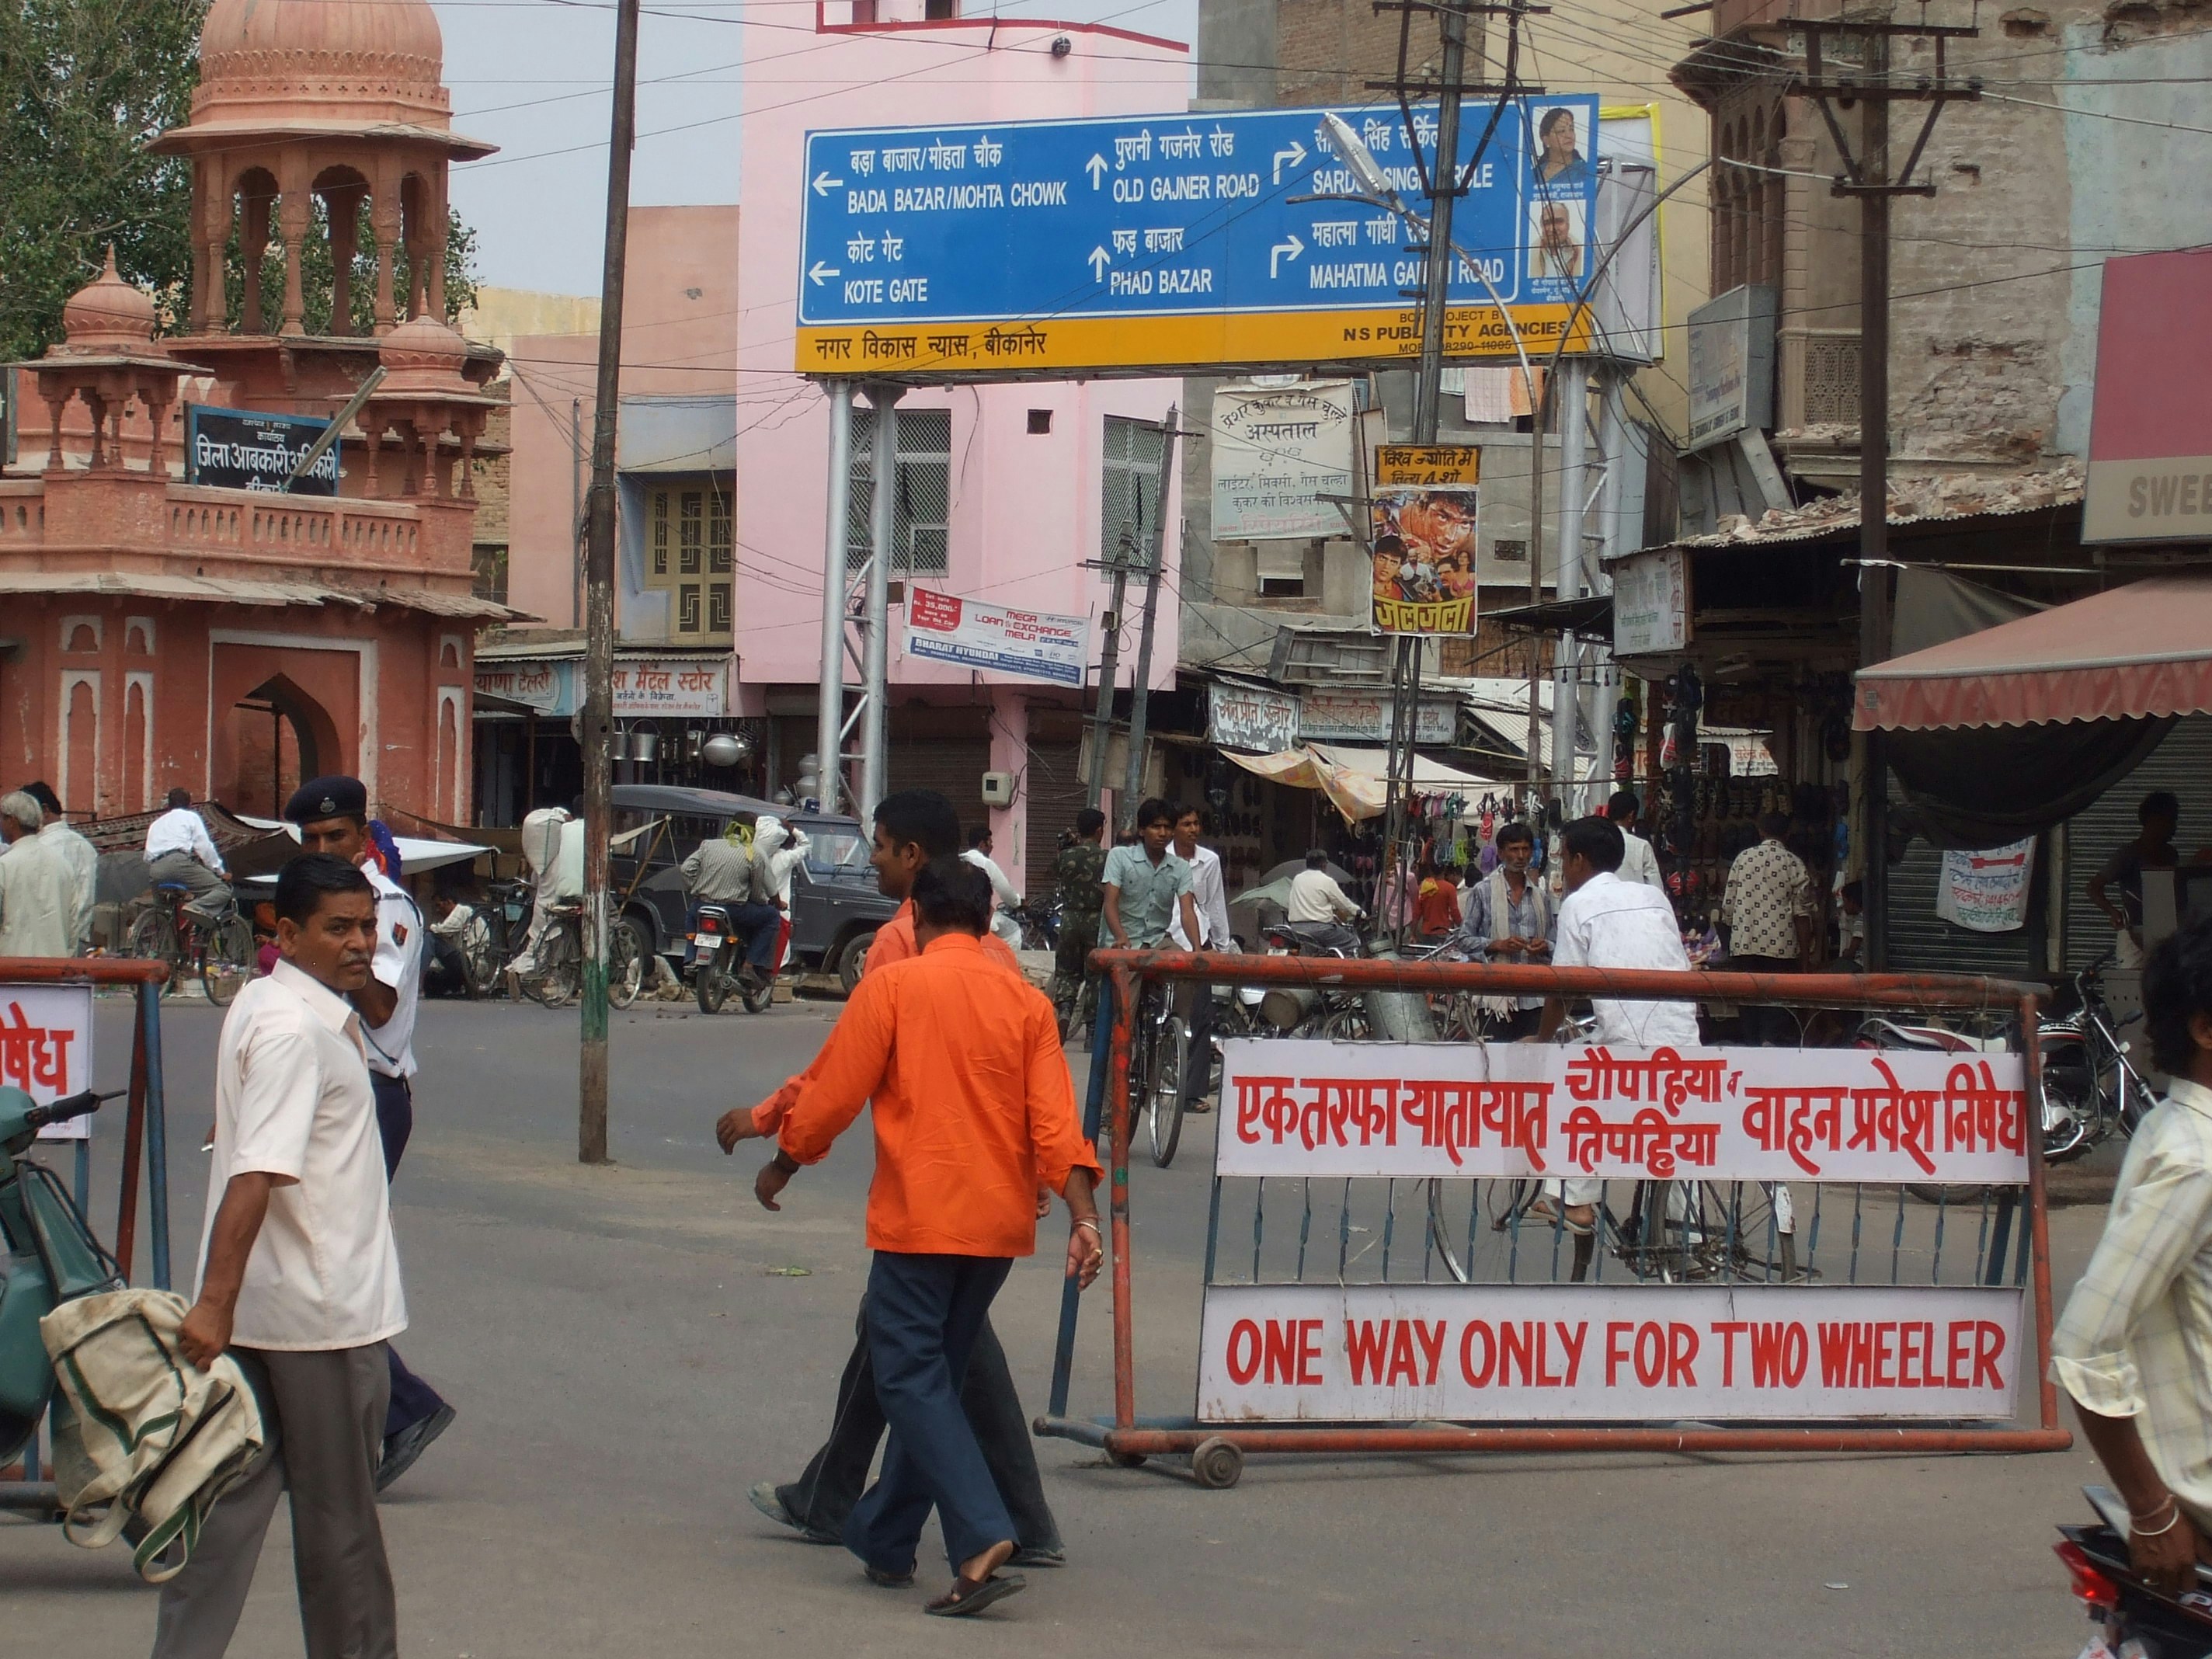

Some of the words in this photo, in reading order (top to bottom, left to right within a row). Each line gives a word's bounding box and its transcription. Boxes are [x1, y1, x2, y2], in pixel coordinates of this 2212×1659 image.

[850, 150, 875, 176] बड़ा
[973, 135, 1003, 169] चौक
[1115, 128, 1152, 170] पुरानी
[1160, 126, 1202, 160] गजनेर
[1209, 124, 1234, 157] रोड
[1113, 178, 1144, 203] OLD
[1151, 175, 1210, 200] GAJNER
[1216, 173, 1260, 198] ROAD
[1313, 169, 1365, 194] SARD
[1448, 163, 1493, 190] RCLE
[848, 190, 887, 214] BADA
[894, 185, 1004, 212] BAZAR/MOHTA
[1011, 181, 1067, 207] CHOWK
[1145, 227, 1184, 252] बाजार
[1311, 221, 1358, 248] महात्मा
[1365, 210, 1398, 245] गांधी
[847, 231, 875, 263] कोट
[882, 229, 904, 262] गेट
[1111, 270, 1152, 295] PHAD
[1159, 268, 1212, 294] BAZAR
[1310, 263, 1388, 289] MAHATMA
[1458, 258, 1504, 284] ROAD
[844, 280, 883, 304] KOTE
[889, 278, 928, 302] GATE
[1376, 323, 1470, 340] PUBLTY
[1442, 311, 1486, 323] OJECT
[815, 339, 852, 360] नगर
[862, 329, 918, 359] विकास
[984, 325, 1048, 356] बीकानेर
[256, 429, 286, 443] कार्यालय
[1245, 422, 1319, 443] अस्पताल
[196, 433, 230, 468] जिला
[230, 442, 290, 475] आबकारी
[1382, 450, 1414, 467] विश्व
[1414, 449, 1459, 467] ज्योति
[1232, 496, 1258, 513] कुकर
[975, 614, 1003, 628] LOAN
[1013, 622, 1072, 638] EXCHANGE
[1006, 610, 1038, 624] MEGA
[1373, 596, 1474, 632] जलजला
[915, 638, 955, 653] BHARAT
[955, 646, 999, 661] HYUNDAI
[1004, 628, 1036, 642] MELA
[677, 664, 716, 691] स्टोर
[0, 1000, 75, 1096] षेध
[1564, 1045, 1727, 1118] चौपहिया
[1742, 1086, 1849, 1176] वाहन
[1845, 1058, 1941, 1176] प्रवेश
[1560, 1105, 1722, 1177] तिपहिया
[1226, 1318, 1323, 1386] ONE
[1345, 1319, 1447, 1387] WAY
[1459, 1319, 1589, 1389] ONLY
[1605, 1320, 1699, 1389] FOR
[1710, 1320, 1809, 1389] TWO
[1817, 1320, 2006, 1390] WHEELER
